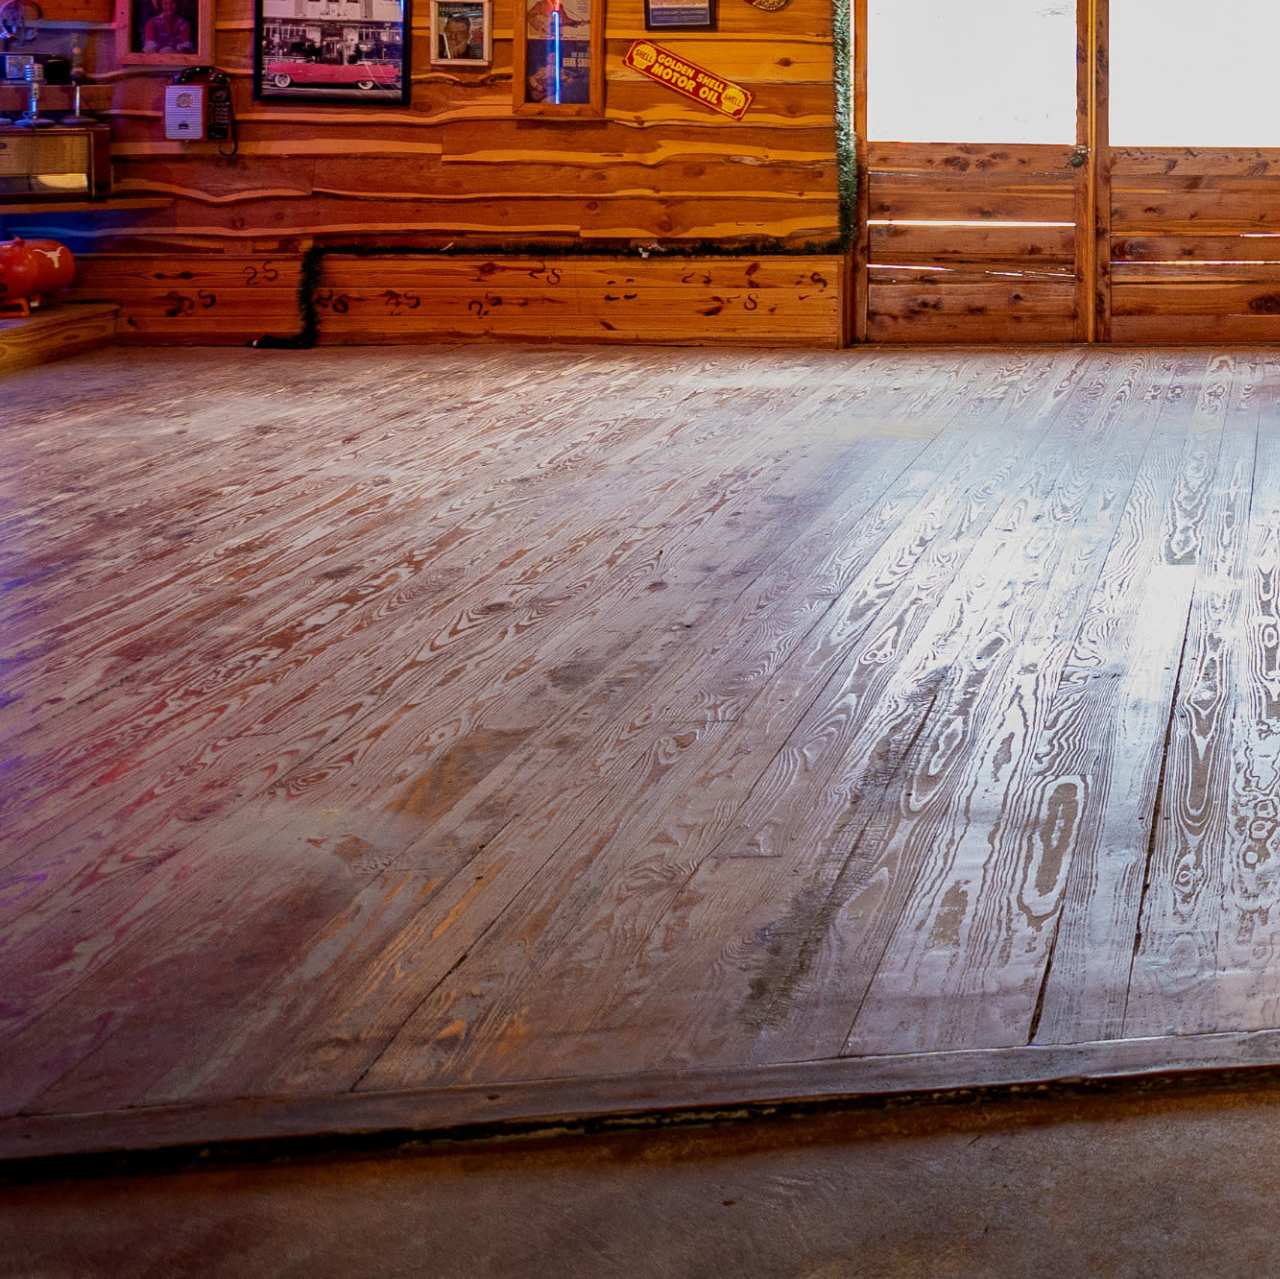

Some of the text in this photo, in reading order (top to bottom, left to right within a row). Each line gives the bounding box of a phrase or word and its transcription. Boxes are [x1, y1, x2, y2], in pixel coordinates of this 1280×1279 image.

[651, 63, 718, 104] MOTOR OIL
[657, 54, 725, 93] GOLDEN SHELL
